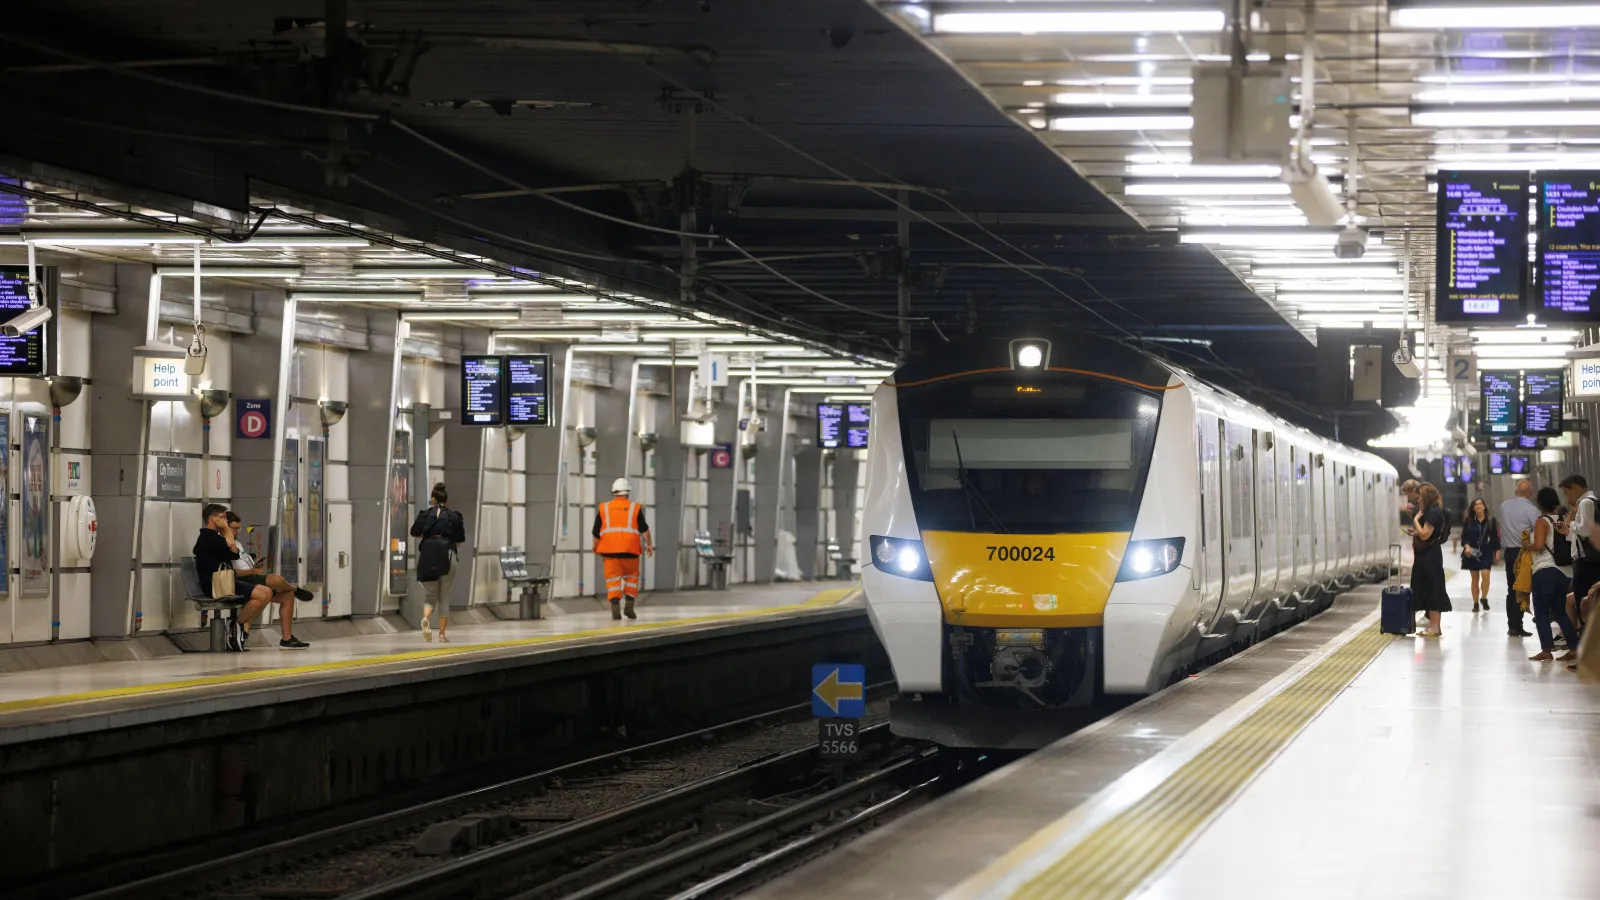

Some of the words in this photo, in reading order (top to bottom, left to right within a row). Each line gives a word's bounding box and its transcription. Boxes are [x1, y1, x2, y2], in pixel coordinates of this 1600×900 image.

[1589, 181, 1595, 190] 6
[154, 363, 175, 374] Help
[712, 360, 717, 381] 1
[1454, 358, 1469, 379] 2
[1582, 363, 1600, 375] Help
[154, 378, 178, 388] point
[1582, 377, 1600, 390] poin
[247, 415, 261, 432] D
[716, 453, 726, 464] C
[986, 546, 1055, 561] 700024
[825, 723, 853, 736] TVS
[822, 741, 857, 753] 5566
